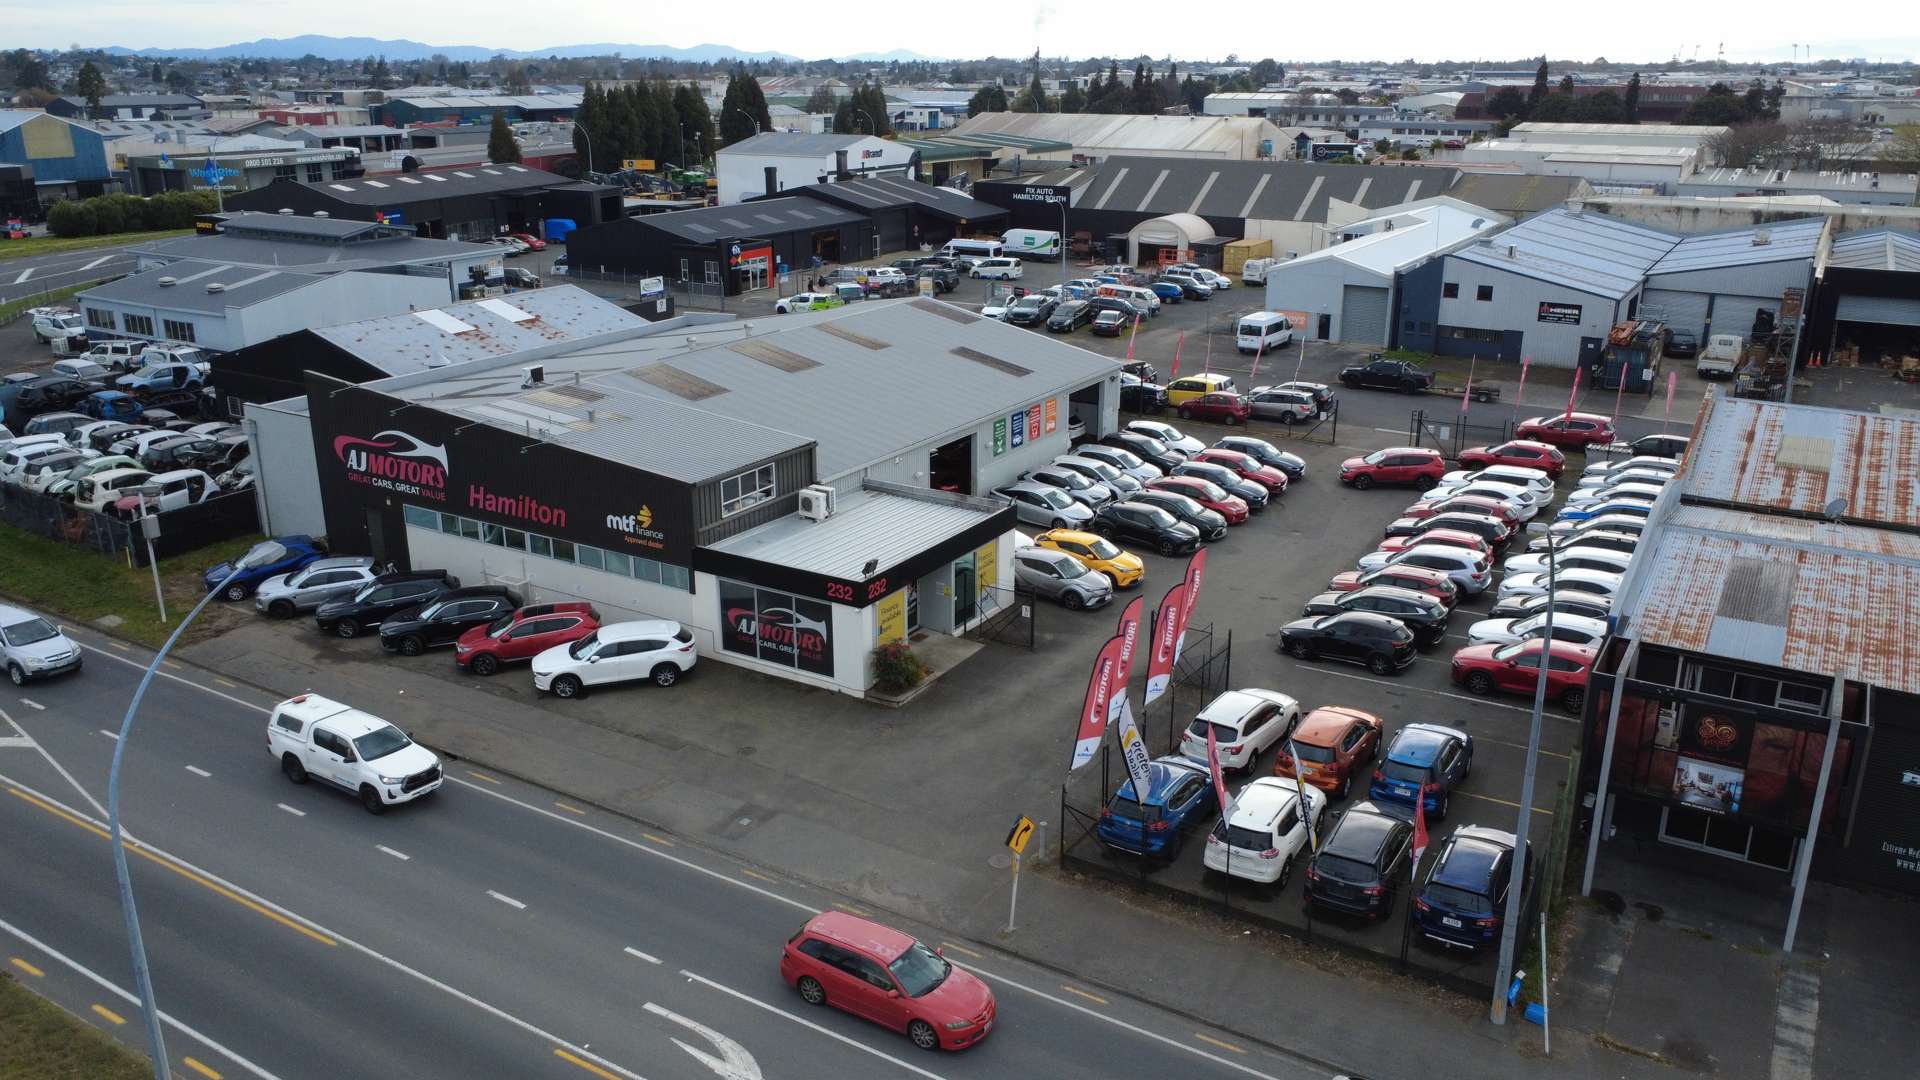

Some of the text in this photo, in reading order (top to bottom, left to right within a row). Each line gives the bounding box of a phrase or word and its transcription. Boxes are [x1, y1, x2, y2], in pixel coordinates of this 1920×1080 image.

[189, 167, 240, 177] WashRite
[1013, 193, 1067, 203] HAMILTON SOUTH
[347, 449, 446, 490] AJ MOTORS
[348, 472, 447, 501] GREAT CARS, GREAT VALUE
[469, 484, 568, 528] Hamilton
[606, 514, 664, 540] mtf finance
[827, 582, 854, 601] 232
[868, 578, 887, 599] 232
[738, 618, 825, 653] AJ MOTORS
[1120, 621, 1137, 662] MOTORS
[1164, 607, 1177, 648] MOTORS
[1096, 659, 1113, 705] MOTORS
